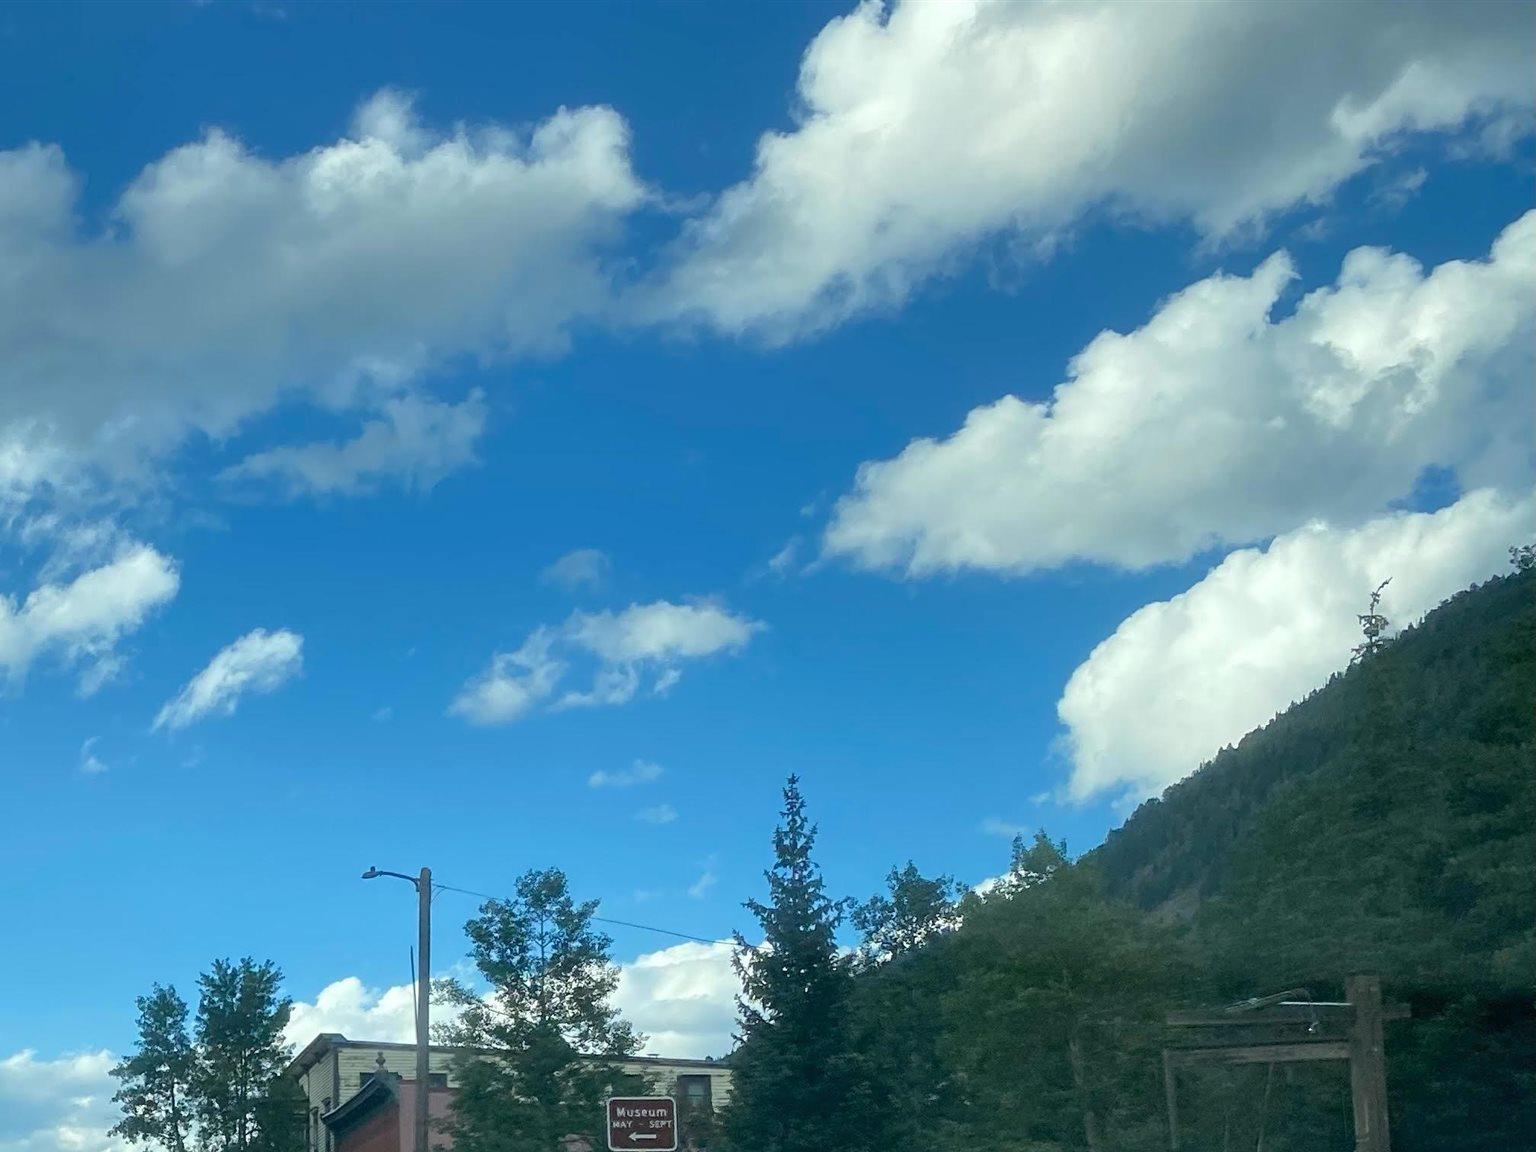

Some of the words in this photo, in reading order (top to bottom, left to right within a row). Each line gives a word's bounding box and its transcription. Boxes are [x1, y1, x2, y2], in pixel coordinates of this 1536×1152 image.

[616, 1106, 667, 1117] Museum
[612, 1120, 633, 1129] MAY
[649, 1120, 672, 1129] SEPT
